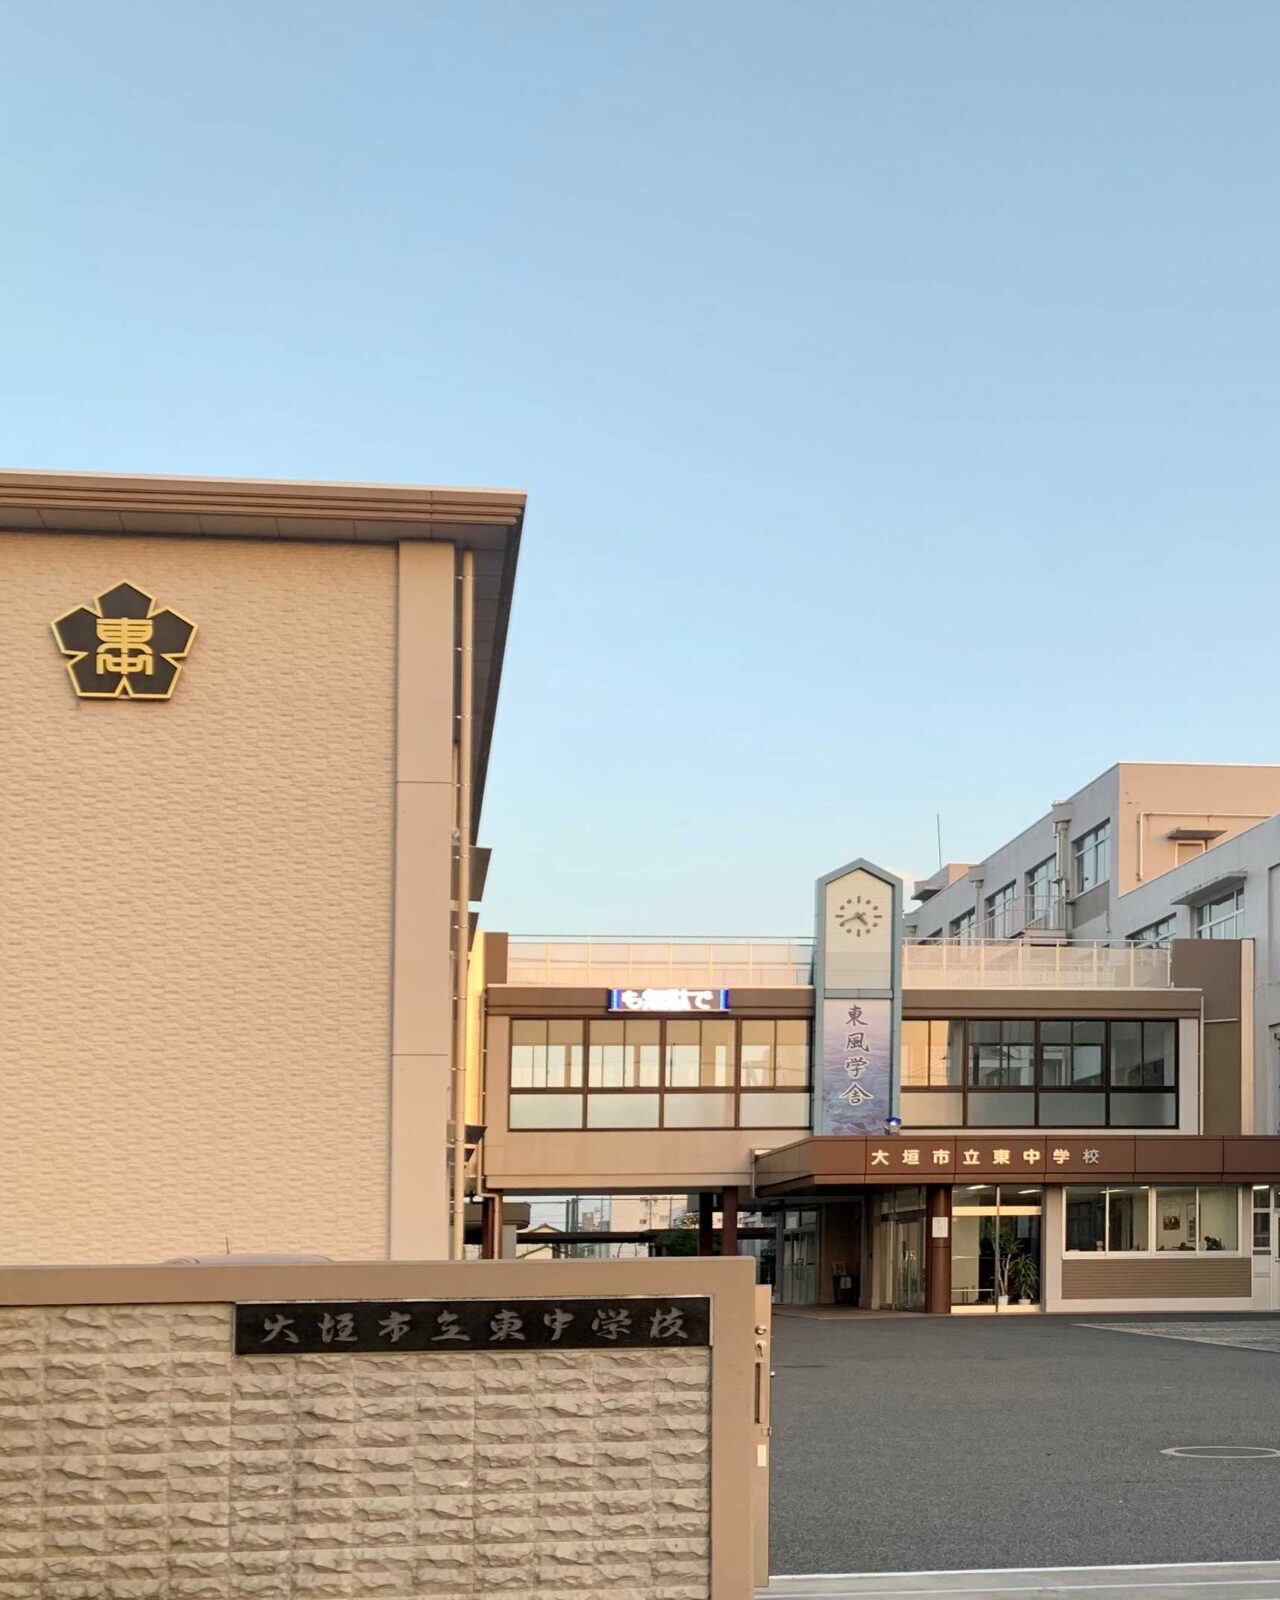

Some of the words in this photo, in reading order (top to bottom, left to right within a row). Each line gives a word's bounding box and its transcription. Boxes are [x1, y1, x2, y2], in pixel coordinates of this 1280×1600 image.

[841, 1004, 873, 1105] 東風学舎
[871, 1149, 1099, 1165] 大垣市立東中学校
[261, 1307, 689, 1343] 大垣市立東中学校
